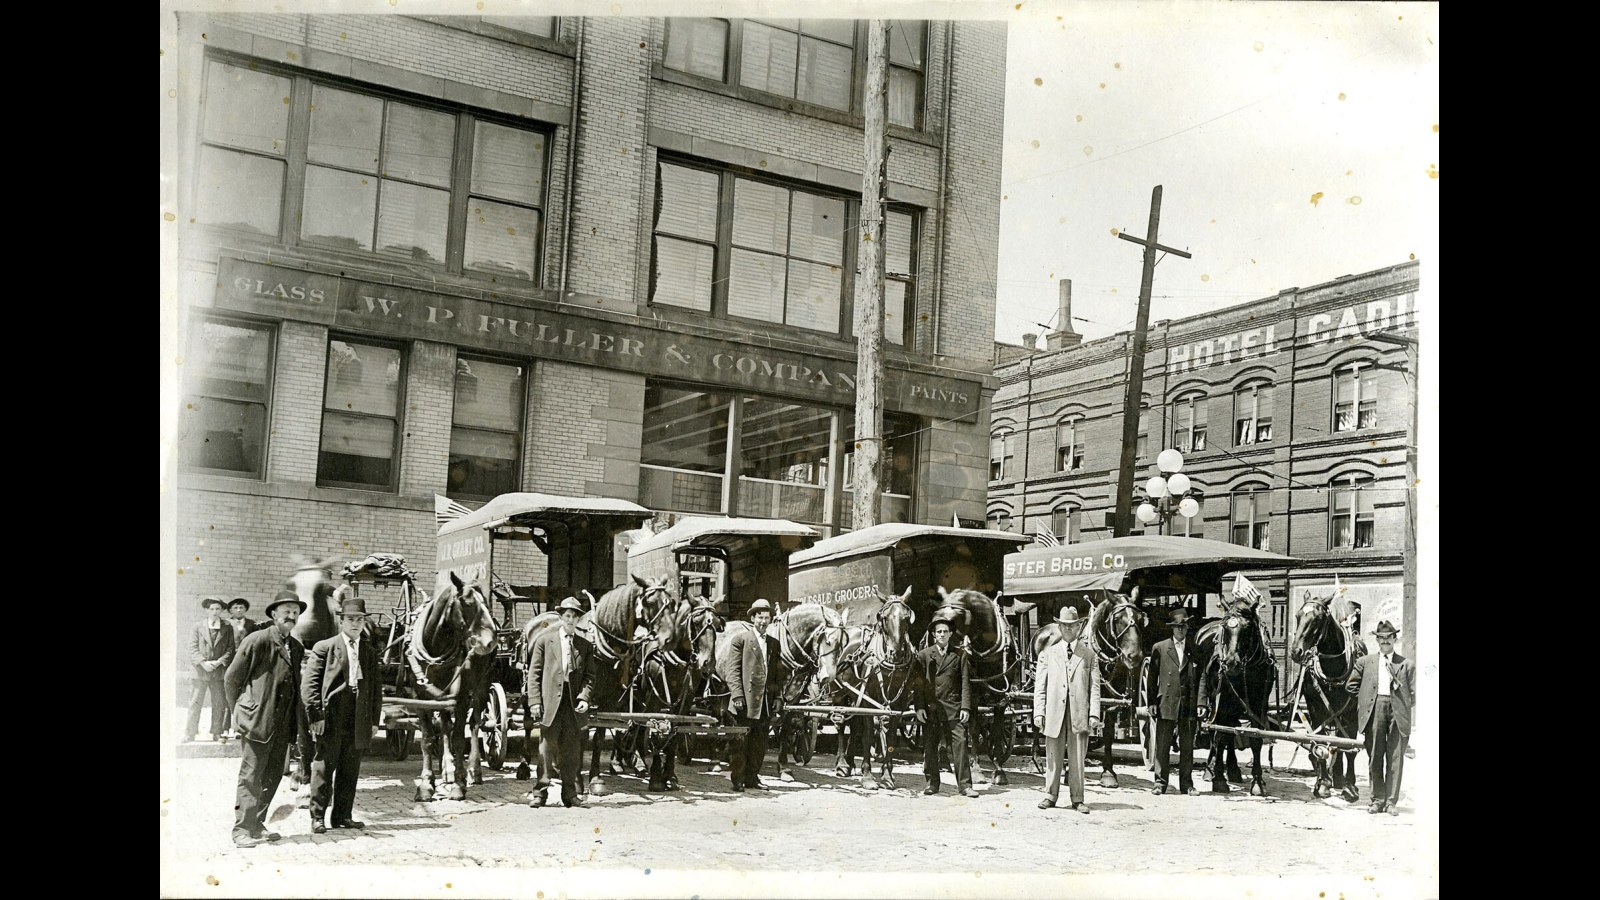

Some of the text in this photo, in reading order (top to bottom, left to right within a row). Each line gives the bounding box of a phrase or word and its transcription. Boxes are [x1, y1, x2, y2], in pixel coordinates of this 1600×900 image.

[234, 276, 326, 303] GLASS
[361, 295, 858, 392] W. P. FULLER & COMPAN
[1170, 325, 1279, 377] HOTEL
[910, 385, 968, 405] PAINTS
[1006, 553, 1128, 575] STER BROS. CO.
[794, 584, 879, 605] OLESALE GROCERS
